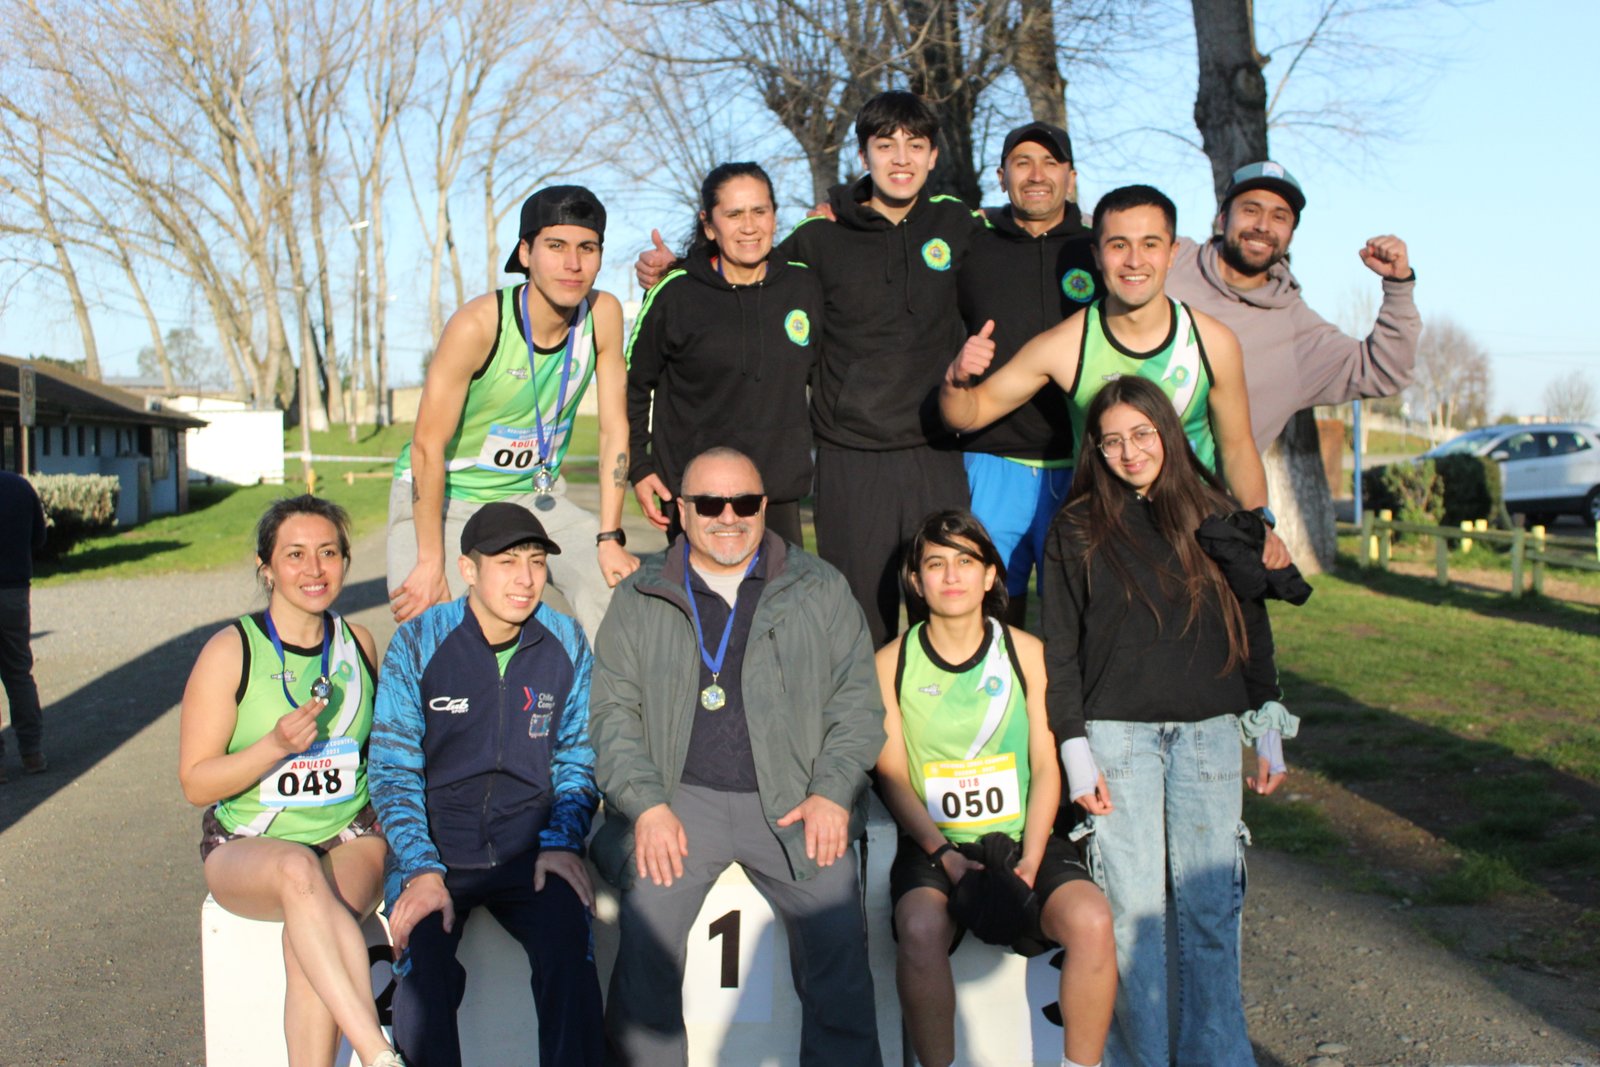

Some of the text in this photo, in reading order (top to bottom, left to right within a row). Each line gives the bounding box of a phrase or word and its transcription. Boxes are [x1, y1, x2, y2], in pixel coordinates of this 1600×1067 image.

[511, 439, 545, 448] ADULT
[429, 696, 469, 711] Club
[291, 758, 332, 770] ADULTO
[278, 768, 342, 796] 048
[959, 777, 980, 788] U18
[942, 787, 1004, 819] 050
[708, 910, 741, 988] 1
